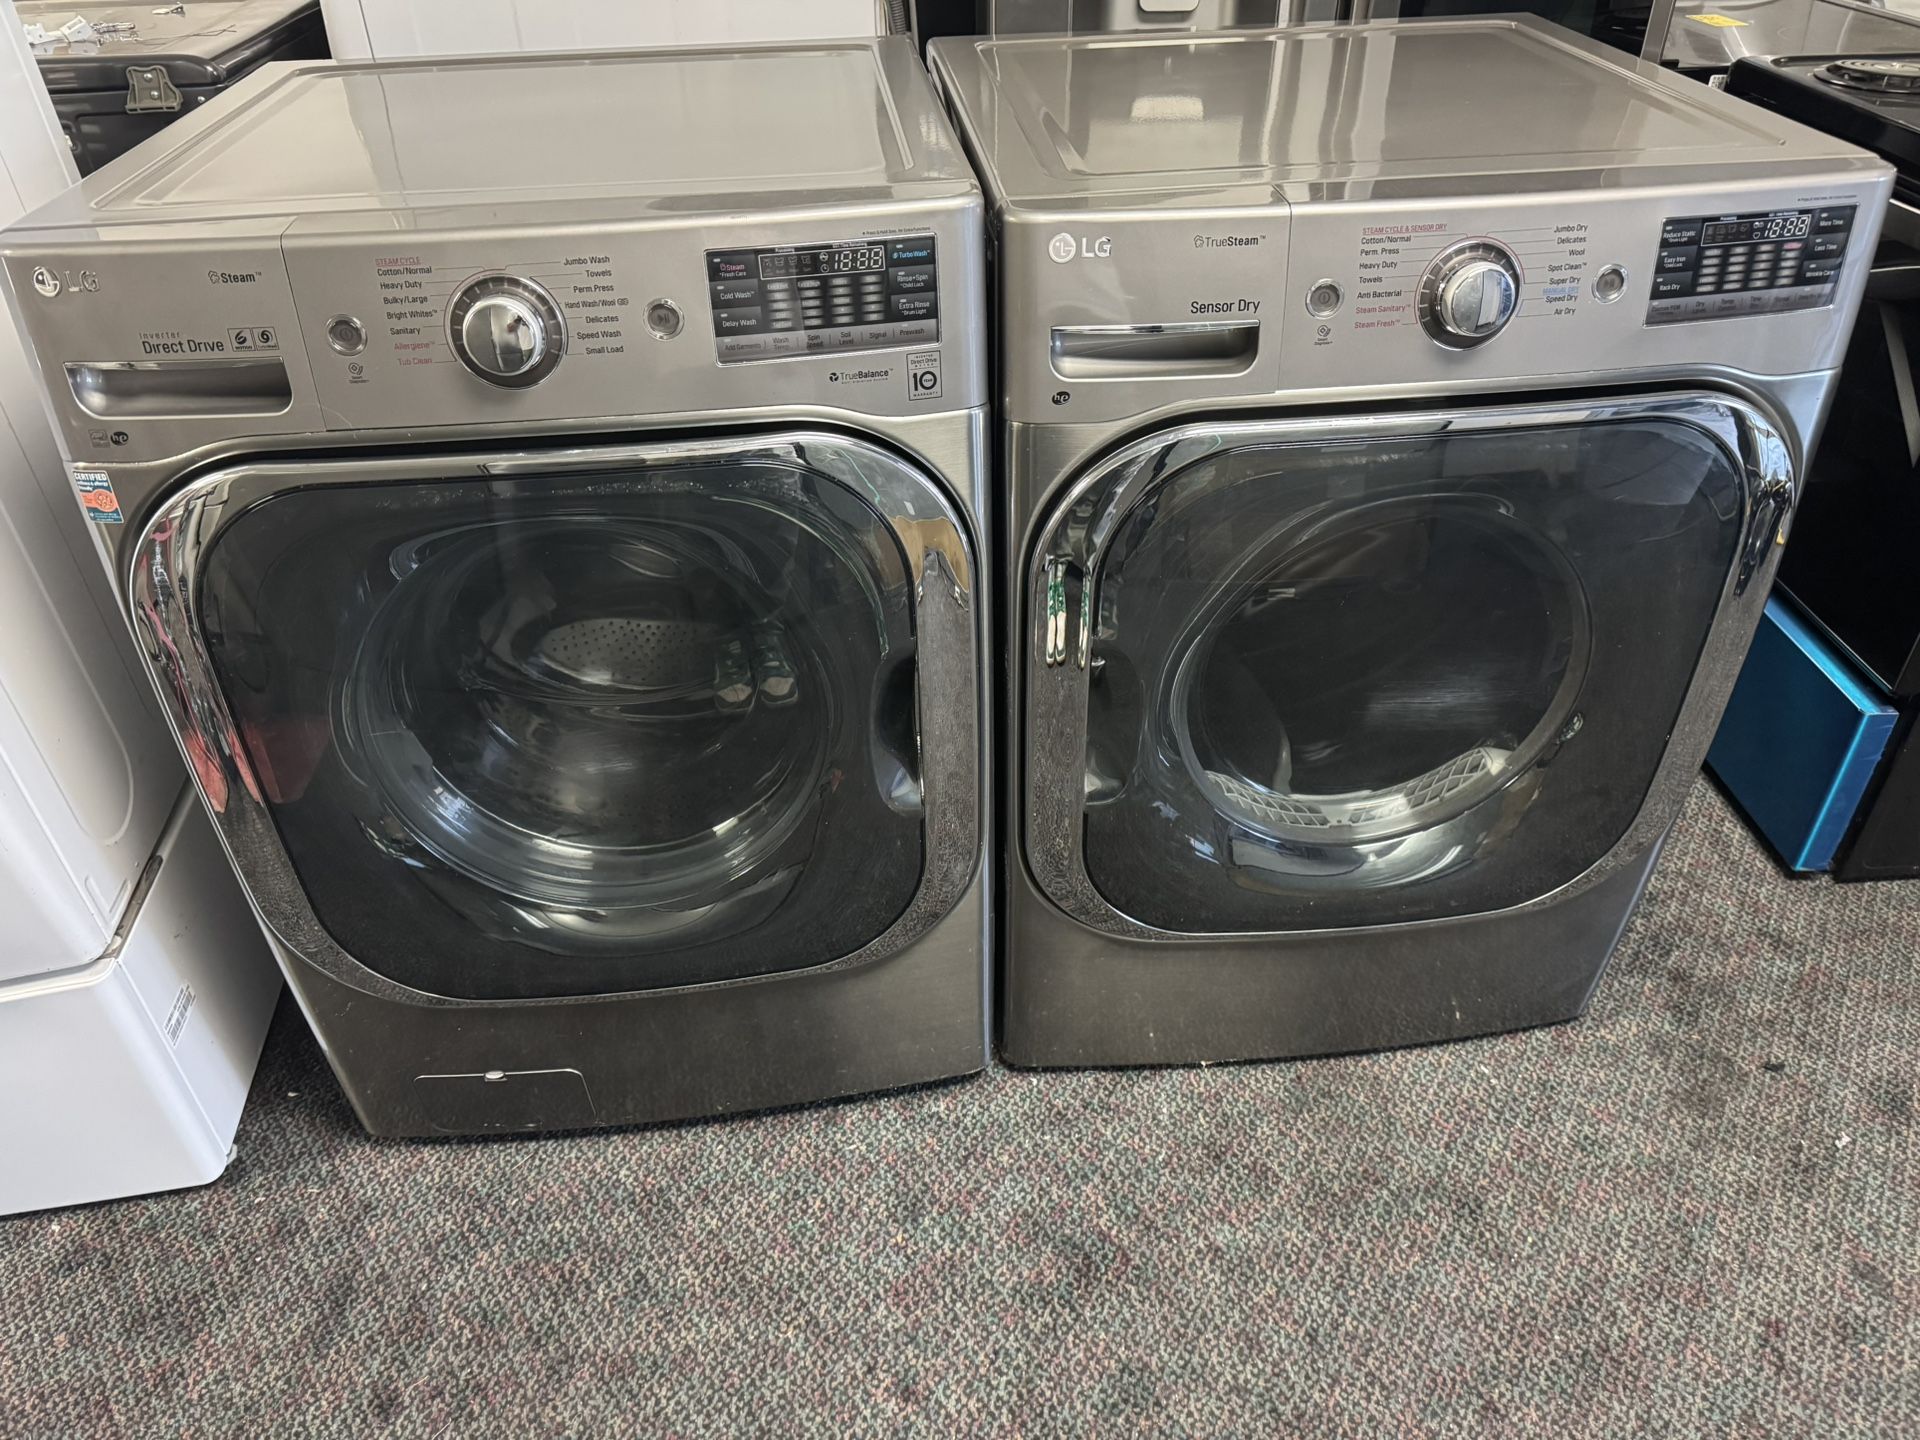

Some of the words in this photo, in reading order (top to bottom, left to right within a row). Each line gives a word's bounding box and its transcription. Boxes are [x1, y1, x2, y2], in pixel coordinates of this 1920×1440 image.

[1362, 226, 1384, 235] STEAM
[1385, 225, 1404, 234] CYCLE
[1411, 224, 1434, 233] SENSOR
[1435, 223, 1447, 231] DRY
[1554, 225, 1575, 233] Jumbo
[1576, 224, 1588, 232] Dry
[1361, 235, 1411, 245] Cotton/Normal
[1557, 236, 1587, 244] Delicates
[1081, 236, 1112, 258] LG
[1380, 247, 1399, 255] Press
[1569, 248, 1585, 256] Wool
[375, 258, 399, 267] STEAM
[400, 256, 421, 266] CYCLE
[564, 257, 588, 266] Jumbo
[588, 255, 610, 264] Wash
[727, 263, 744, 271] Steam
[1359, 262, 1380, 270] Heavy
[1381, 261, 1397, 269] Duty
[1547, 264, 1563, 272] Spot
[377, 266, 432, 276] Cotton/Normal
[585, 269, 612, 278] Towels
[64, 269, 100, 293] LG
[1359, 276, 1383, 284] Towels
[1569, 276, 1581, 284] Dry
[380, 281, 403, 290] Heavy
[404, 280, 422, 289] Duty
[594, 284, 614, 292] Press
[720, 292, 734, 300] Cold
[1357, 291, 1371, 299] Anti
[1372, 290, 1402, 298] Bacterial
[1545, 295, 1566, 303] Speed
[1567, 294, 1578, 302] Dry
[383, 295, 428, 305] Bulky/Large
[565, 301, 580, 309] Hand
[1190, 300, 1235, 314] Sensor
[1237, 298, 1261, 314] Dry
[1356, 306, 1377, 314] Steam
[1564, 307, 1576, 316] Dry
[386, 311, 408, 320] Bright
[585, 315, 619, 324] Delicates
[722, 320, 739, 328] Delay
[740, 318, 757, 326] Wash
[1355, 321, 1375, 329] Steam
[390, 327, 421, 336] Sanitary
[577, 331, 599, 340] Speed
[600, 329, 622, 338] Wash
[142, 340, 186, 355] Direct
[187, 338, 225, 353] Drive
[586, 347, 605, 355] Small
[606, 345, 624, 354] Load
[398, 358, 411, 366] Tub
[412, 357, 433, 365] Clean
[912, 370, 938, 392] 10
[74, 472, 107, 481] CERTIFIED
